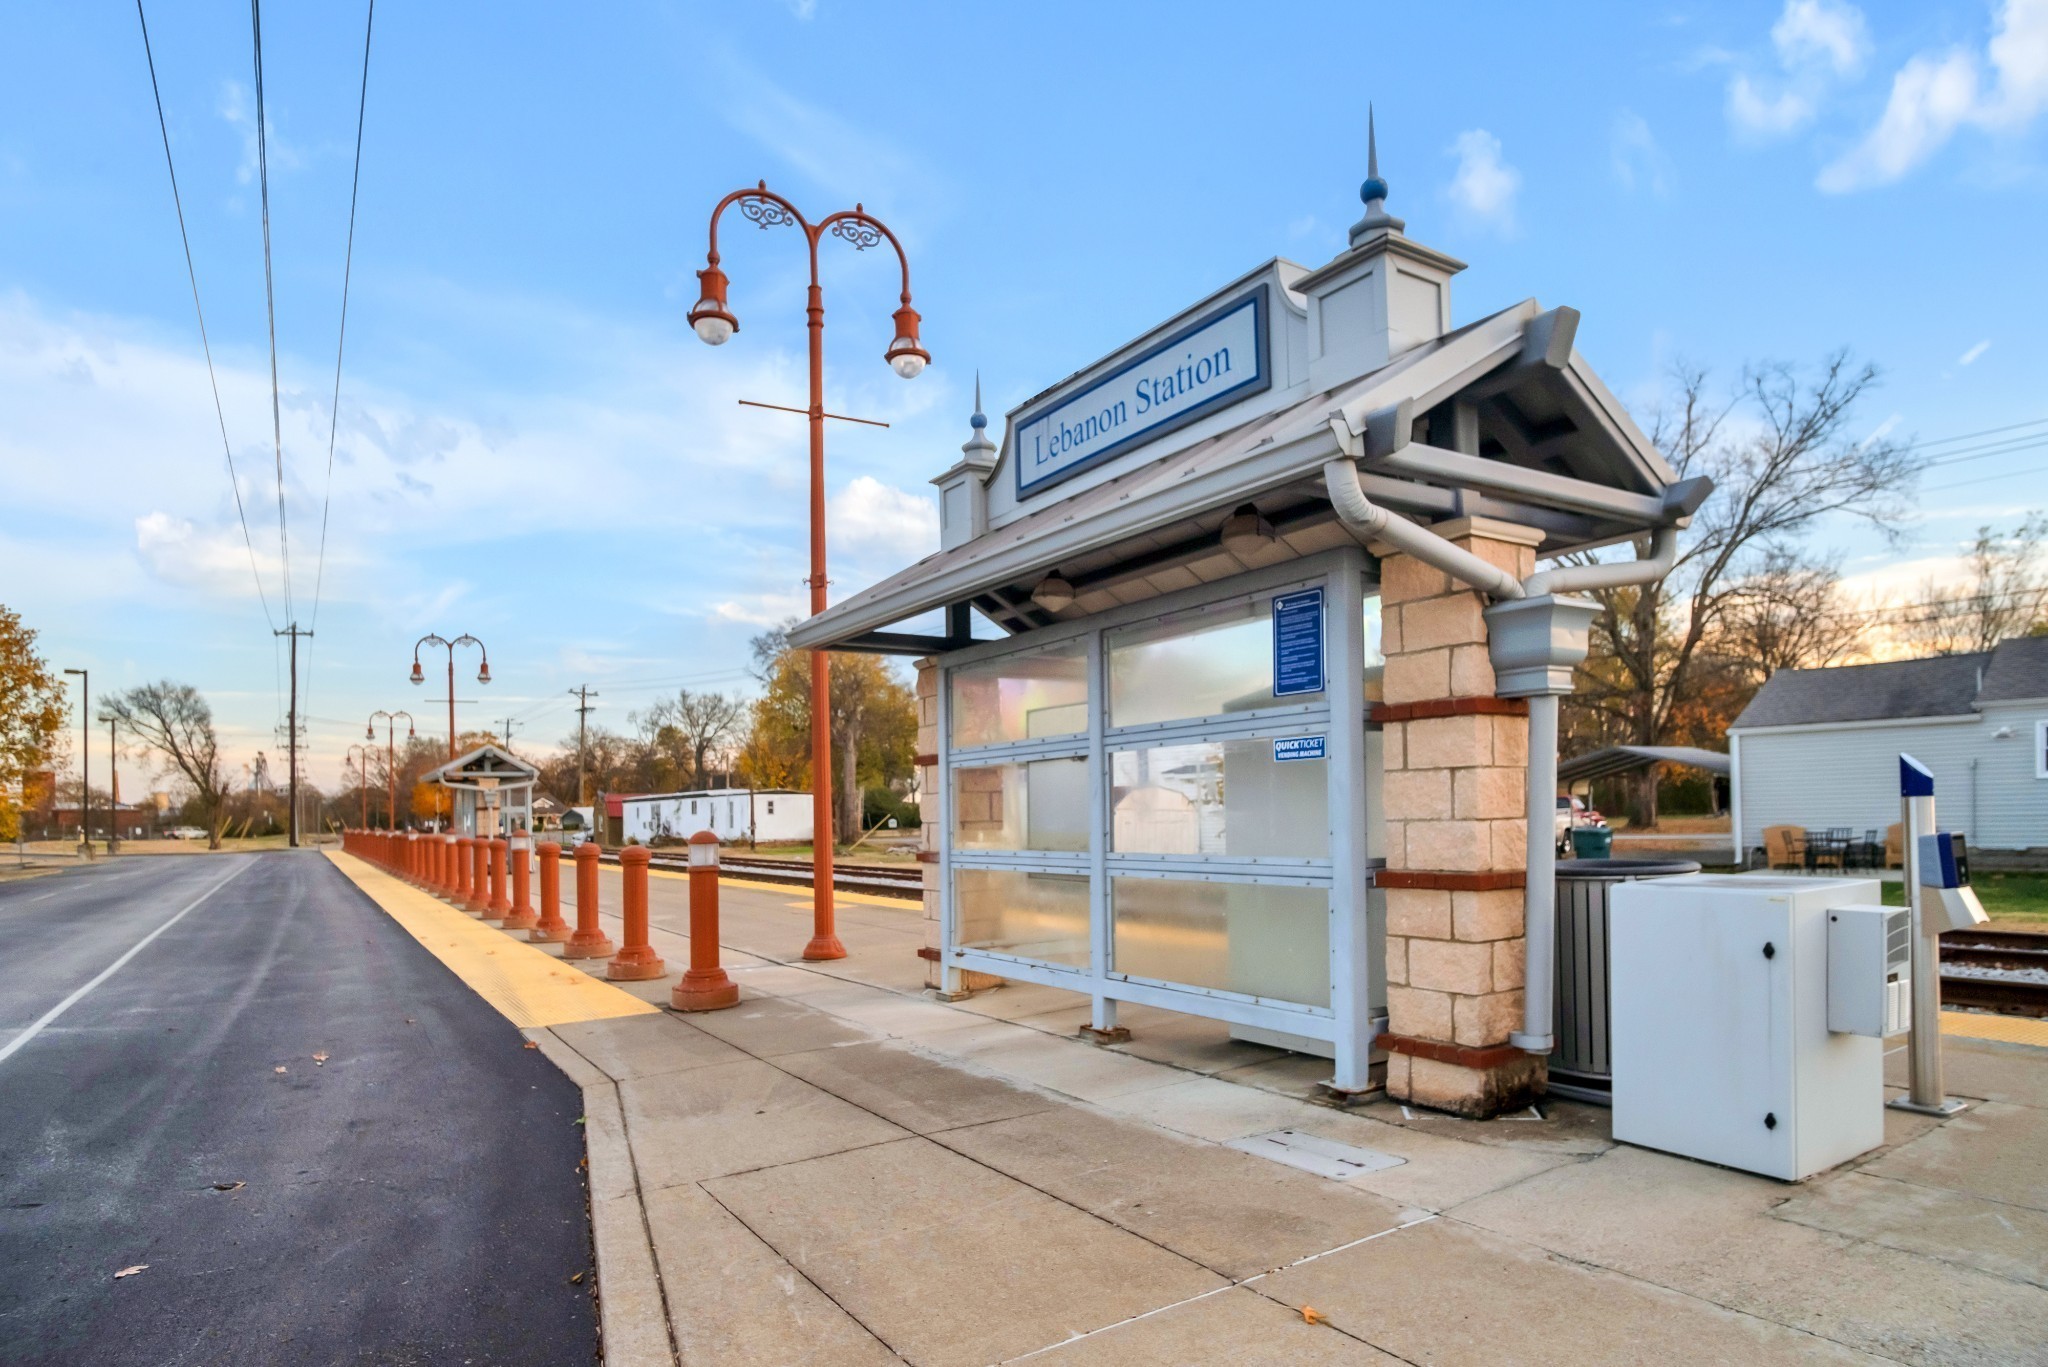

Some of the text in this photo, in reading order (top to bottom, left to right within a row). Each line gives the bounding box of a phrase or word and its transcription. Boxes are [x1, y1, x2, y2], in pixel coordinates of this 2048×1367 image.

[1035, 347, 1232, 465] Lebanon Station
[1275, 738, 1324, 752] QUICKTICKET
[1300, 749, 1322, 757] MACHINE
